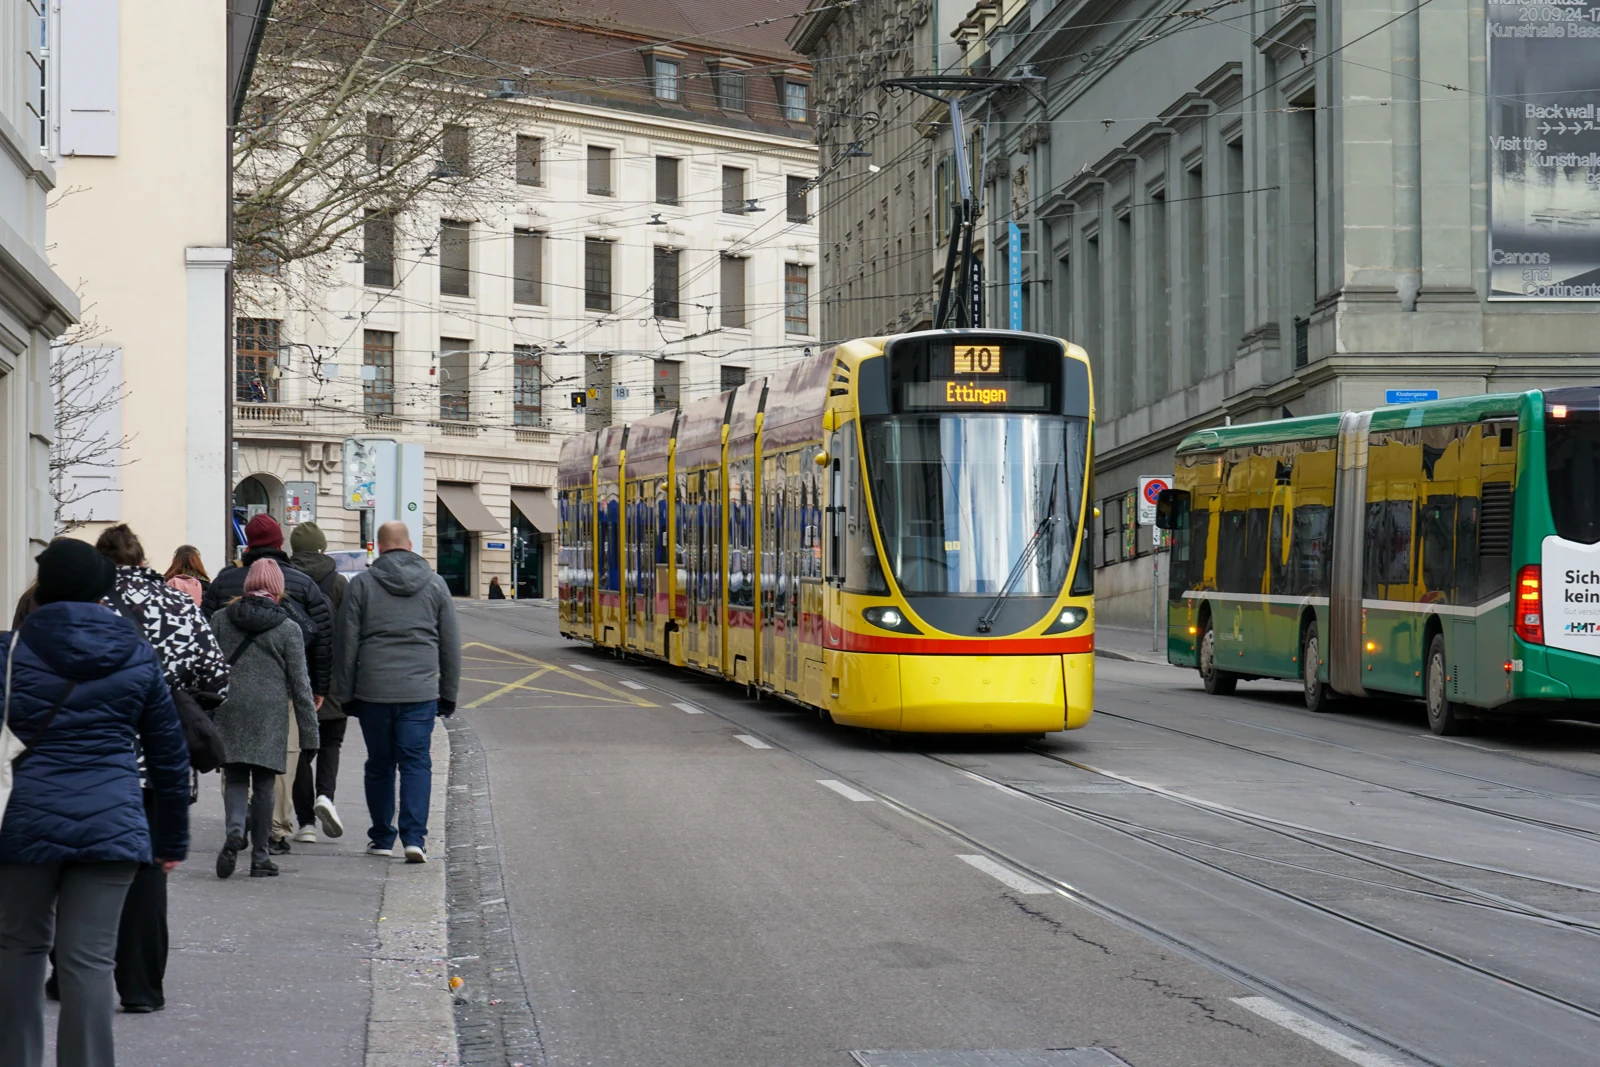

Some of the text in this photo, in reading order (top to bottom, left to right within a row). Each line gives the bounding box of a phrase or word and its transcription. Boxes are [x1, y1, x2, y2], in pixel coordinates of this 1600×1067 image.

[1490, 22, 1565, 38] Kunsthalle
[1525, 104, 1563, 118] Back
[1565, 104, 1594, 118] wall
[1490, 136, 1547, 151] Visit the
[1529, 153, 1600, 167] Kunsthalle
[1491, 249, 1550, 264] Canons
[1522, 267, 1551, 281] and
[1523, 282, 1600, 297] Continents
[964, 347, 992, 371] 10
[946, 381, 1007, 404] Ettingen
[1565, 570, 1600, 584] Sich
[1565, 589, 1600, 603] kein
[1571, 622, 1596, 633] HMT
